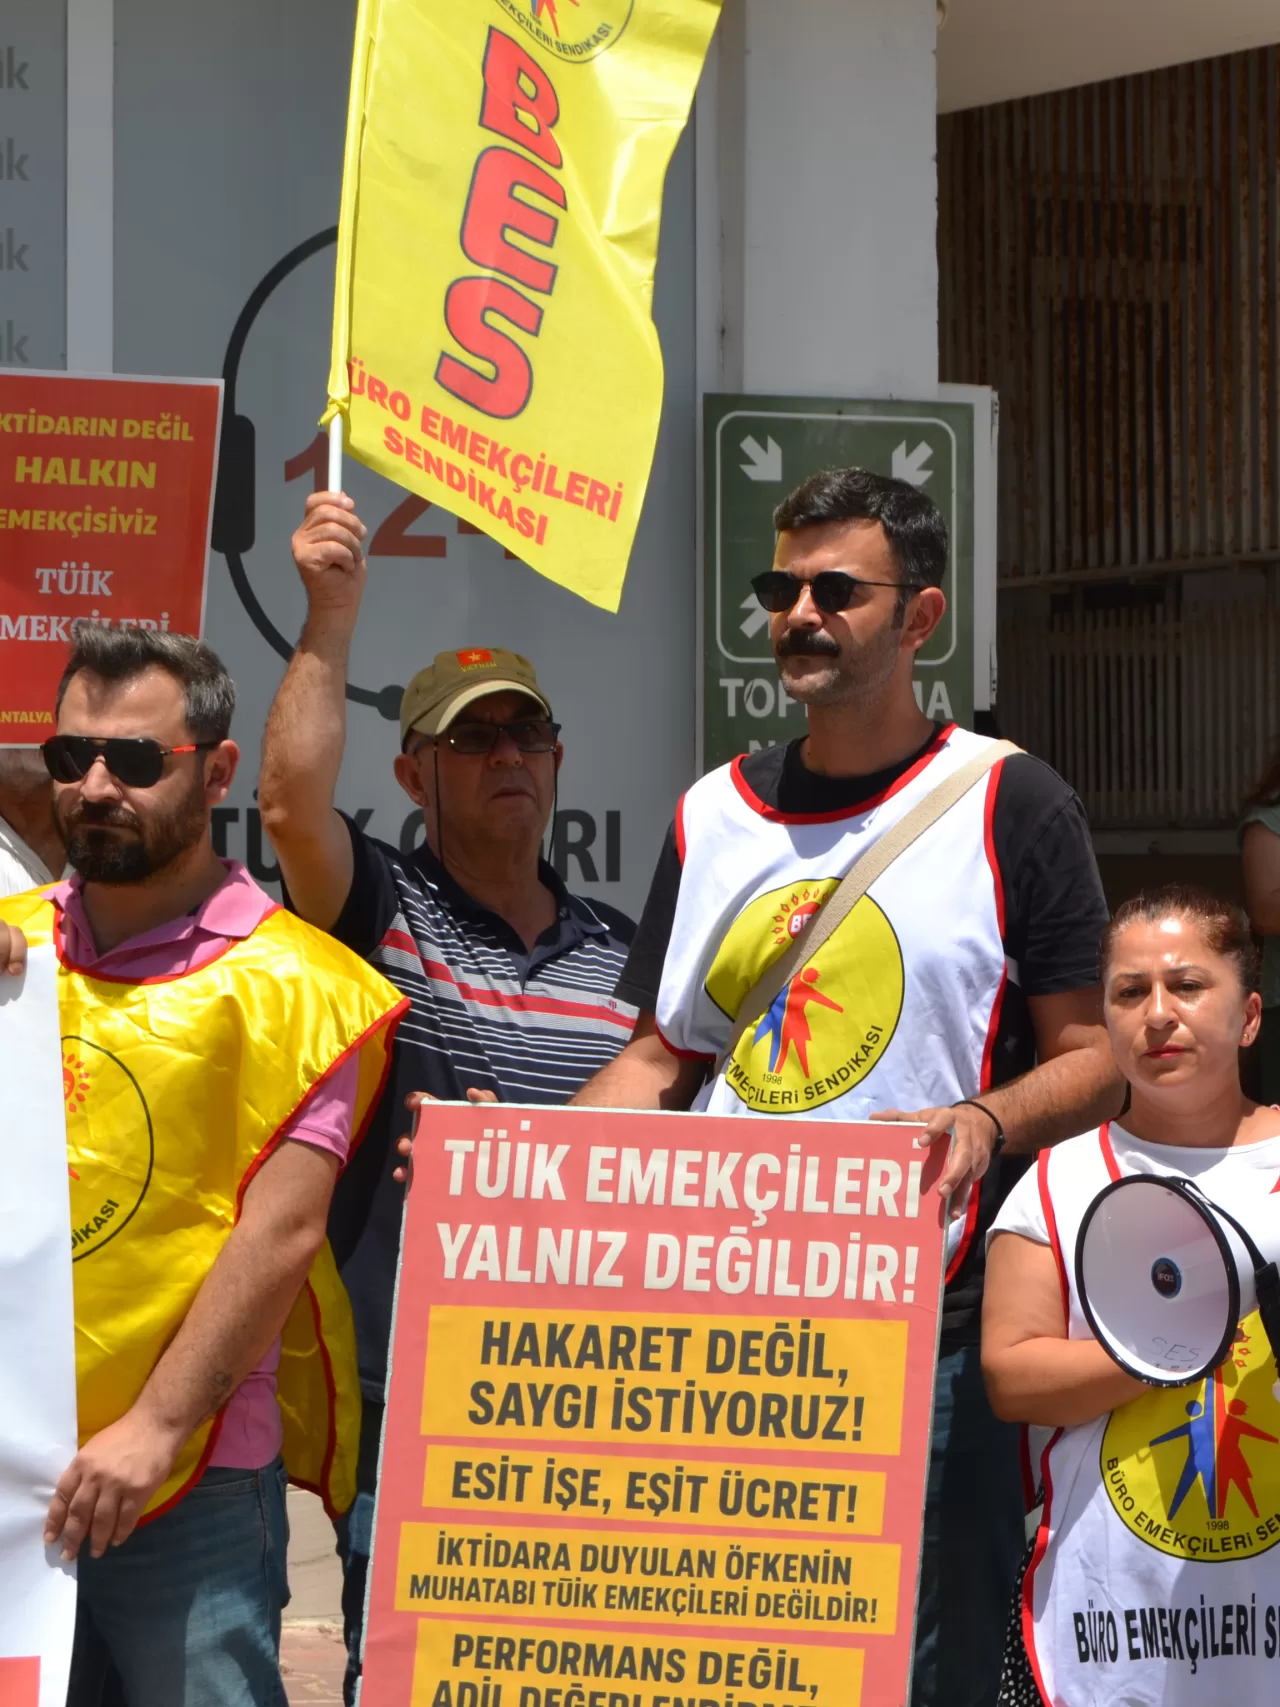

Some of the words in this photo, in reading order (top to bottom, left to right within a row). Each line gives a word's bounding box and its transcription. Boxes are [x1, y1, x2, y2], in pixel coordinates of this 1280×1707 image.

[434, 24, 568, 420] BES
[0, 408, 117, 437] KTİDARIN
[123, 412, 194, 441] DEĞİL
[346, 356, 411, 421] ÜRO
[421, 405, 624, 523] EMEKÇİLERİ
[15, 455, 156, 489] HALKIN
[383, 427, 548, 546] SENDİKASI
[0, 505, 157, 539] EMEKÇİSİYİZ
[36, 561, 113, 596] TÜİK
[0, 711, 53, 724] NTALYA
[761, 1073, 783, 1086] 1998
[804, 1025, 884, 1100] SENDİKASI
[444, 1120, 571, 1200] TÜİK
[585, 1138, 923, 1227] EMEKÇİLERİ
[436, 1222, 627, 1288] YALNIZ
[480, 1320, 692, 1373] HAKARET
[705, 1319, 849, 1388] DEĞİL,
[468, 1380, 597, 1430] SAYGI
[611, 1378, 865, 1442] İSTİYORUZ!
[543, 1458, 611, 1515] İŞE,
[626, 1466, 708, 1517] EŞİT
[718, 1470, 857, 1523] ÜCRET!
[1107, 1456, 1136, 1512] BÜRO
[1133, 1511, 1254, 1555] EMEKÇİLERİ
[436, 1530, 571, 1571] İKTİDARA
[580, 1544, 716, 1579] DUYULAN
[725, 1544, 852, 1586] ÖFKENİN
[1205, 1520, 1229, 1531] 1998
[409, 1574, 536, 1606] MUHATABI
[542, 1577, 598, 1609] TÜİK
[604, 1583, 748, 1617] EMEKÇİLERİ
[755, 1588, 877, 1624] DEĞİLDİR!
[1073, 1599, 1118, 1663] BÜRO
[1124, 1593, 1256, 1674] EMEKÇİLERİ
[452, 1633, 686, 1684] PERFORMANS
[698, 1647, 818, 1701] DEĞİL,
